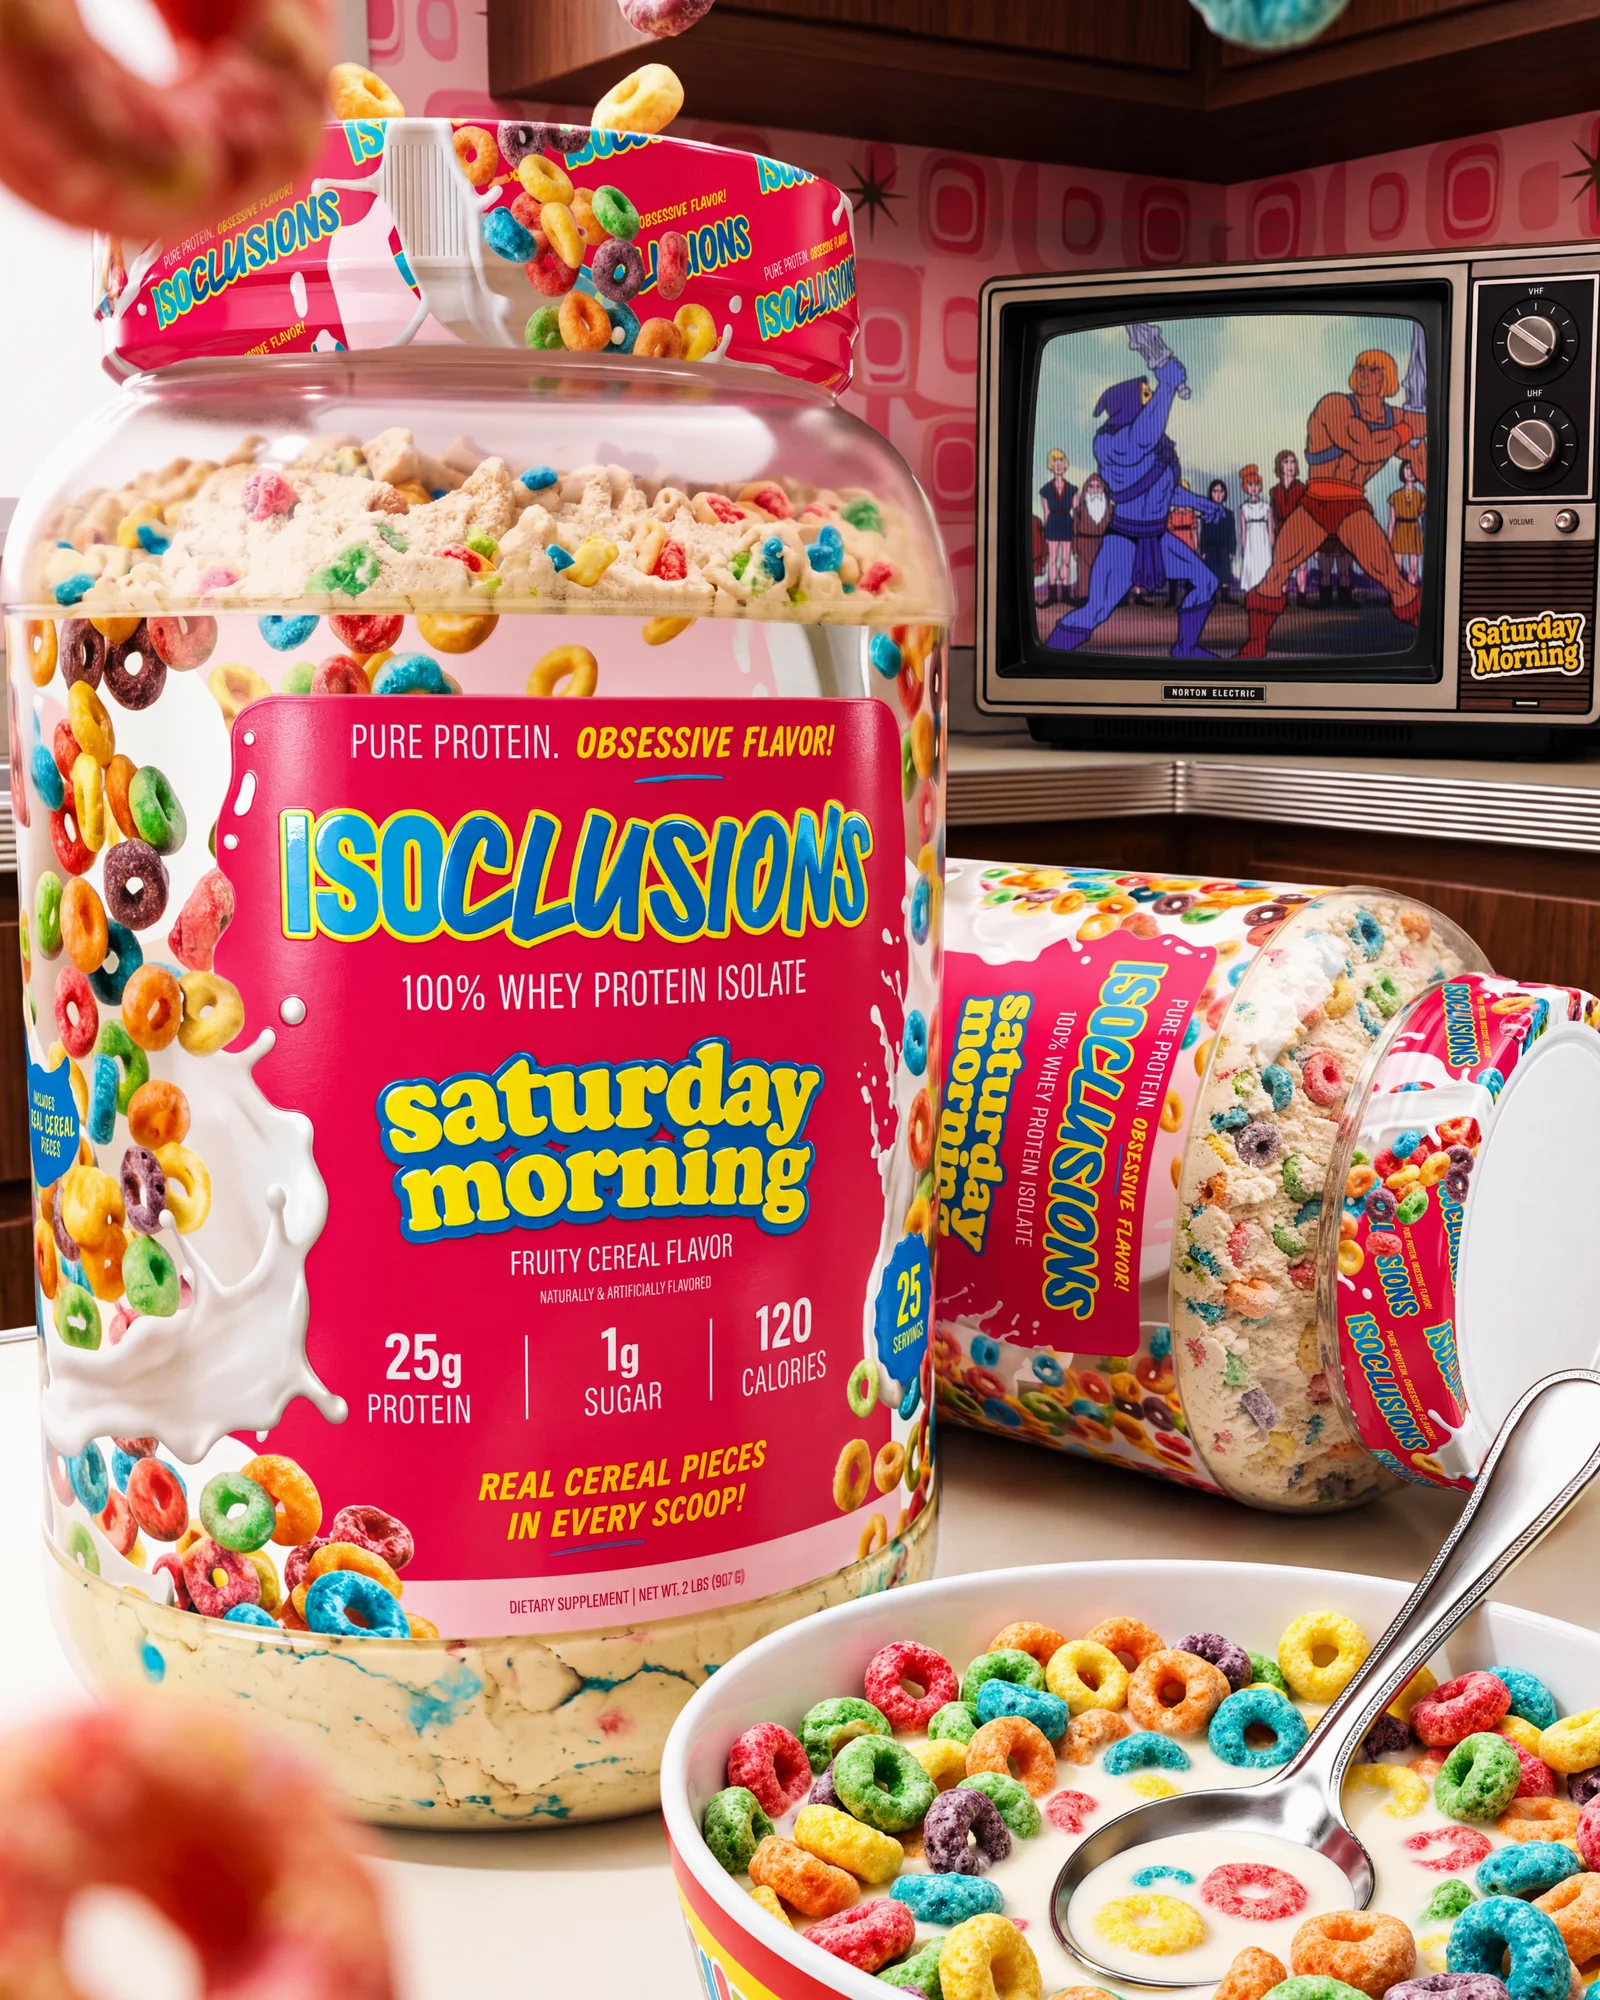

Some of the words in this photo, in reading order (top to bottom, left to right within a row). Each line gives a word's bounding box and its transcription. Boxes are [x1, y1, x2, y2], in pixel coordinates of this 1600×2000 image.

[163, 246, 181, 269] PURE
[182, 226, 215, 256] PROTEIN.
[217, 204, 258, 234] OBSESSIVE
[260, 182, 294, 211] FLAVOR!
[639, 201, 688, 229] OBSESSIVE
[690, 189, 727, 213] FLAVOR!
[151, 189, 340, 331] ISOCLUSIONS
[763, 260, 784, 281] PURE
[756, 254, 855, 341] ISOCLUSION
[1528, 287, 1544, 295] VHF
[269, 320, 307, 349] FLAVOR!
[1527, 389, 1543, 397] UHF
[1509, 518, 1534, 526] VOLUME
[1471, 616, 1580, 647] Saturday
[1476, 642, 1579, 673] Morning
[1172, 688, 1207, 697] NORTON
[1212, 688, 1256, 698] ELECTRIC
[351, 724, 423, 759] PURE
[434, 724, 559, 759] PROTEIN.
[577, 726, 734, 759] OBSESSIVE
[742, 725, 835, 757] FLAVOR!
[279, 800, 873, 948] ISOCLUSIONS
[402, 974, 486, 1011] 100%
[498, 972, 583, 1010] WHEY
[594, 967, 706, 1008] PROTEIN
[717, 959, 807, 1000] ISOLATE
[1048, 1011, 1077, 1051] 100%
[1157, 999, 1189, 1037] PURE
[1442, 983, 1480, 1067] ISOCLUSIONS
[384, 1042, 820, 1154] saturday
[1035, 1056, 1064, 1102] WHEY
[1135, 1040, 1173, 1111] PROTEIN.
[44, 1114, 76, 1138] CEREAL
[951, 994, 1031, 1253] saturday
[1021, 1106, 1050, 1176] PROTEIN
[1042, 960, 1168, 1320] ISOCLUSIONS
[401, 1128, 811, 1225] morning
[1119, 1117, 1149, 1212] OBSESSIVE
[1015, 1180, 1037, 1248] ISOLATE
[511, 1248, 582, 1276] FRUITY
[588, 1243, 661, 1272] CEREAL
[667, 1233, 733, 1265] FLAVOR
[1113, 1218, 1133, 1293] FLAVOR!
[540, 1288, 595, 1304] NATURALLY
[597, 1287, 605, 1301] &
[607, 1281, 666, 1300] ARTIFICIALLY
[668, 1275, 712, 1295] FLAVORED
[896, 1263, 921, 1328] 25
[755, 1297, 812, 1351] 120
[892, 1320, 924, 1354] SERVINGS
[385, 1333, 462, 1389] 25g
[601, 1327, 639, 1379] 1g
[742, 1350, 827, 1397] CALORIES
[584, 1381, 662, 1417] SUGAR
[1345, 1311, 1429, 1450] ISOCLUSIONS
[1385, 1330, 1398, 1348] PURE
[1403, 1378, 1424, 1413] OBSESSIVE
[1417, 1413, 1438, 1440] FLAVOR!
[368, 1393, 471, 1424] PROTEIN
[478, 1470, 555, 1501] REAL
[564, 1458, 671, 1497] CEREAL
[680, 1439, 768, 1483] PIECES
[507, 1511, 541, 1540] IN
[550, 1501, 648, 1538] EVERY
[652, 1483, 746, 1527] SCOOP!
[509, 1598, 556, 1614] DIETARY
[557, 1590, 630, 1611] SUPPLEMENT
[639, 1586, 659, 1602] NET
[660, 1582, 680, 1598] WT.
[682, 1581, 689, 1595] 2
[691, 1577, 709, 1593] LBS
[711, 1570, 733, 1591] (907
